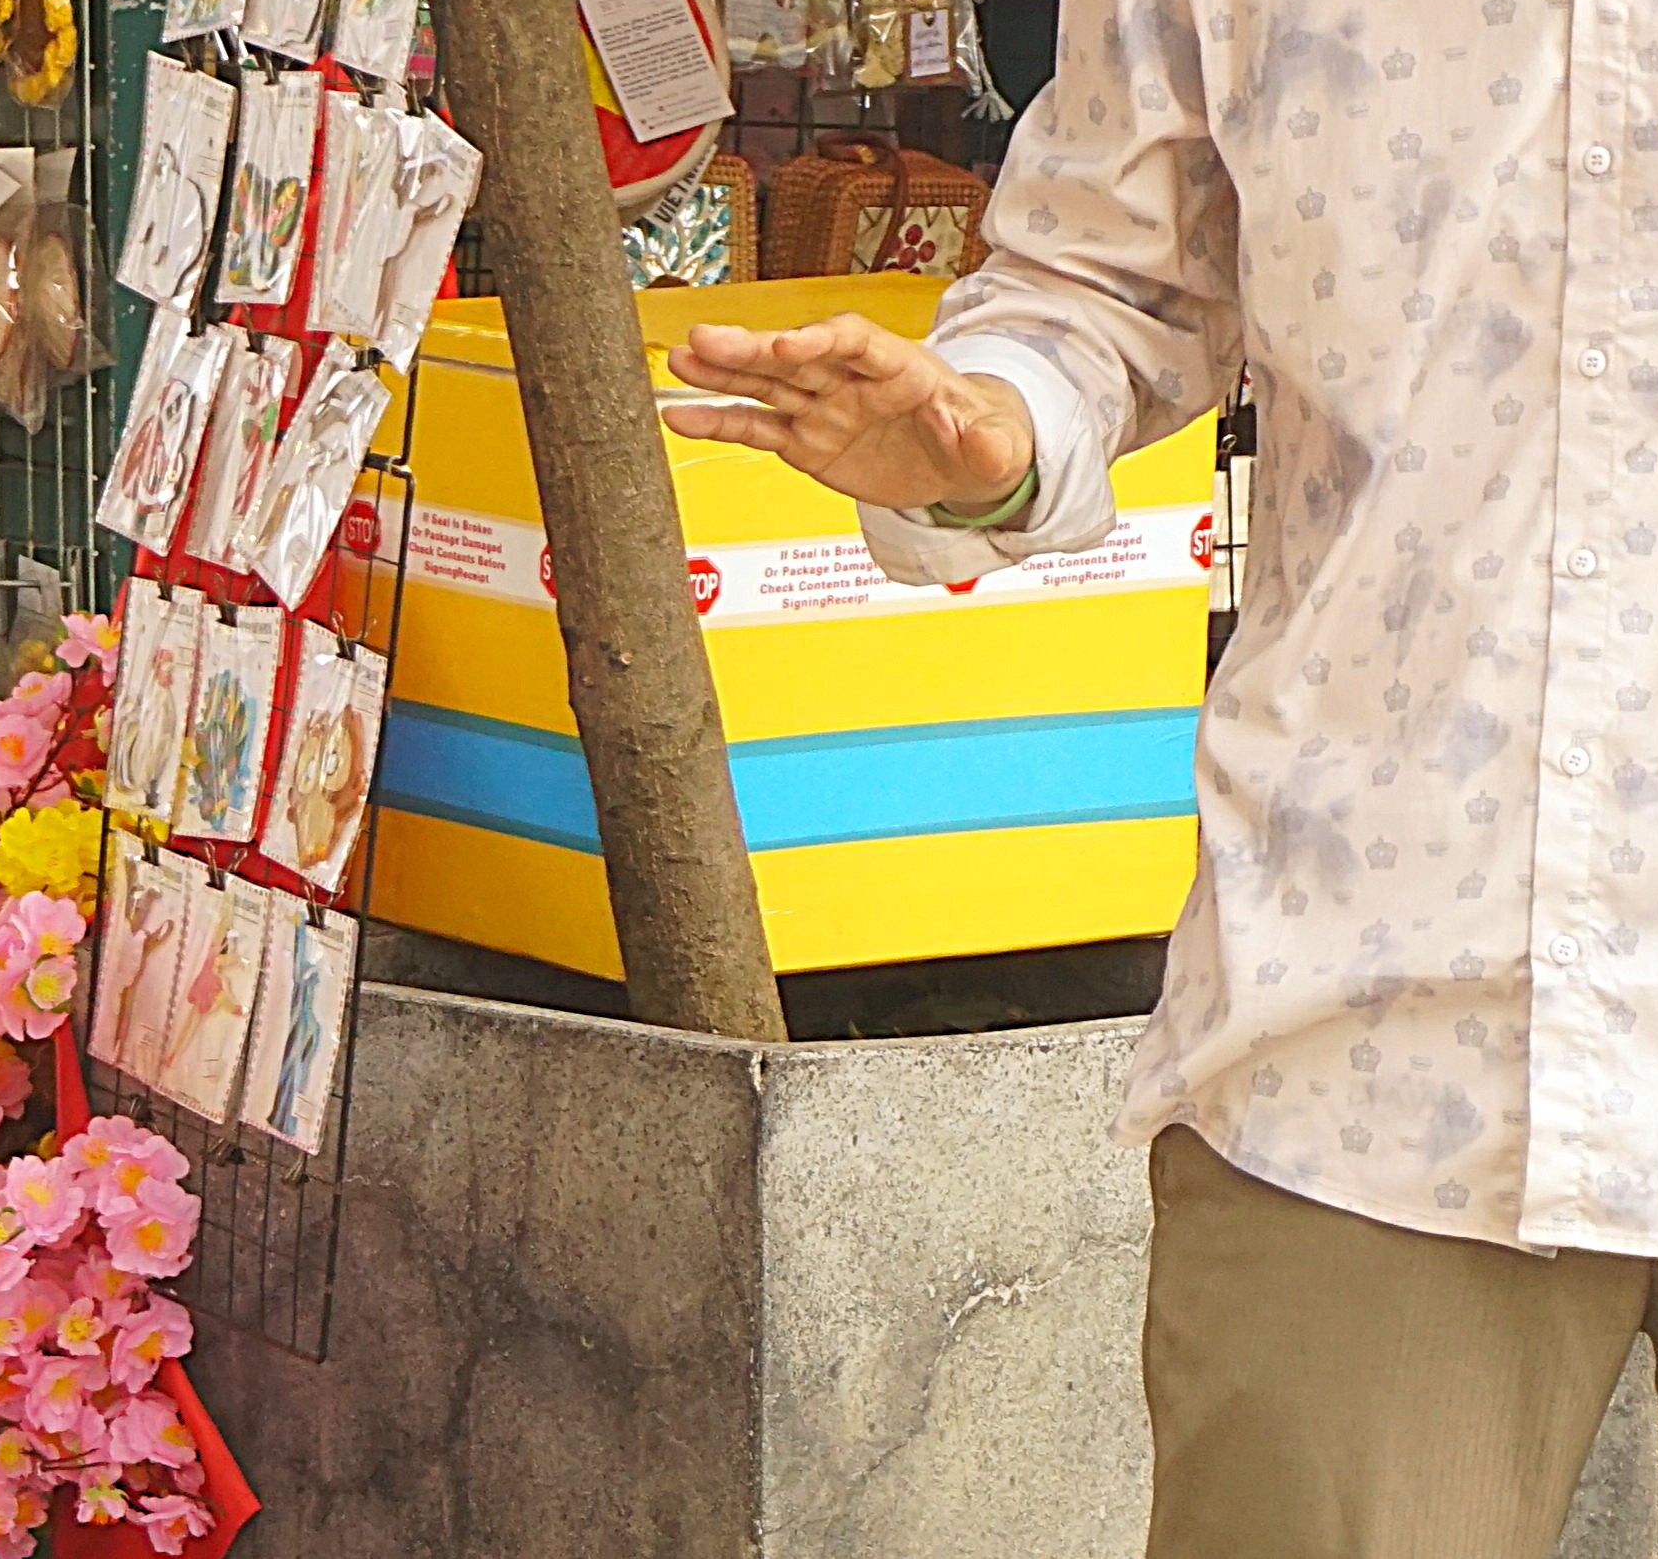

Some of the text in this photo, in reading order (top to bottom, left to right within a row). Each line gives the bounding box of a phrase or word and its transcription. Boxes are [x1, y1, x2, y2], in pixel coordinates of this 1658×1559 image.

[431, 513, 450, 528] Seal
[462, 519, 493, 536] Broken
[411, 526, 503, 554] Or Package Damaged
[409, 541, 507, 571] Check Contents Before
[780, 544, 869, 561] If Seal Is Broke
[1021, 550, 1148, 572] Check Contents Before
[424, 560, 490, 584] SigningReceipt
[764, 560, 880, 579] Or Package Damag
[1042, 568, 1126, 586] SigningReceipt
[760, 582, 795, 595] Check
[798, 578, 851, 592] Contents
[782, 592, 870, 611] SigningReceipt
